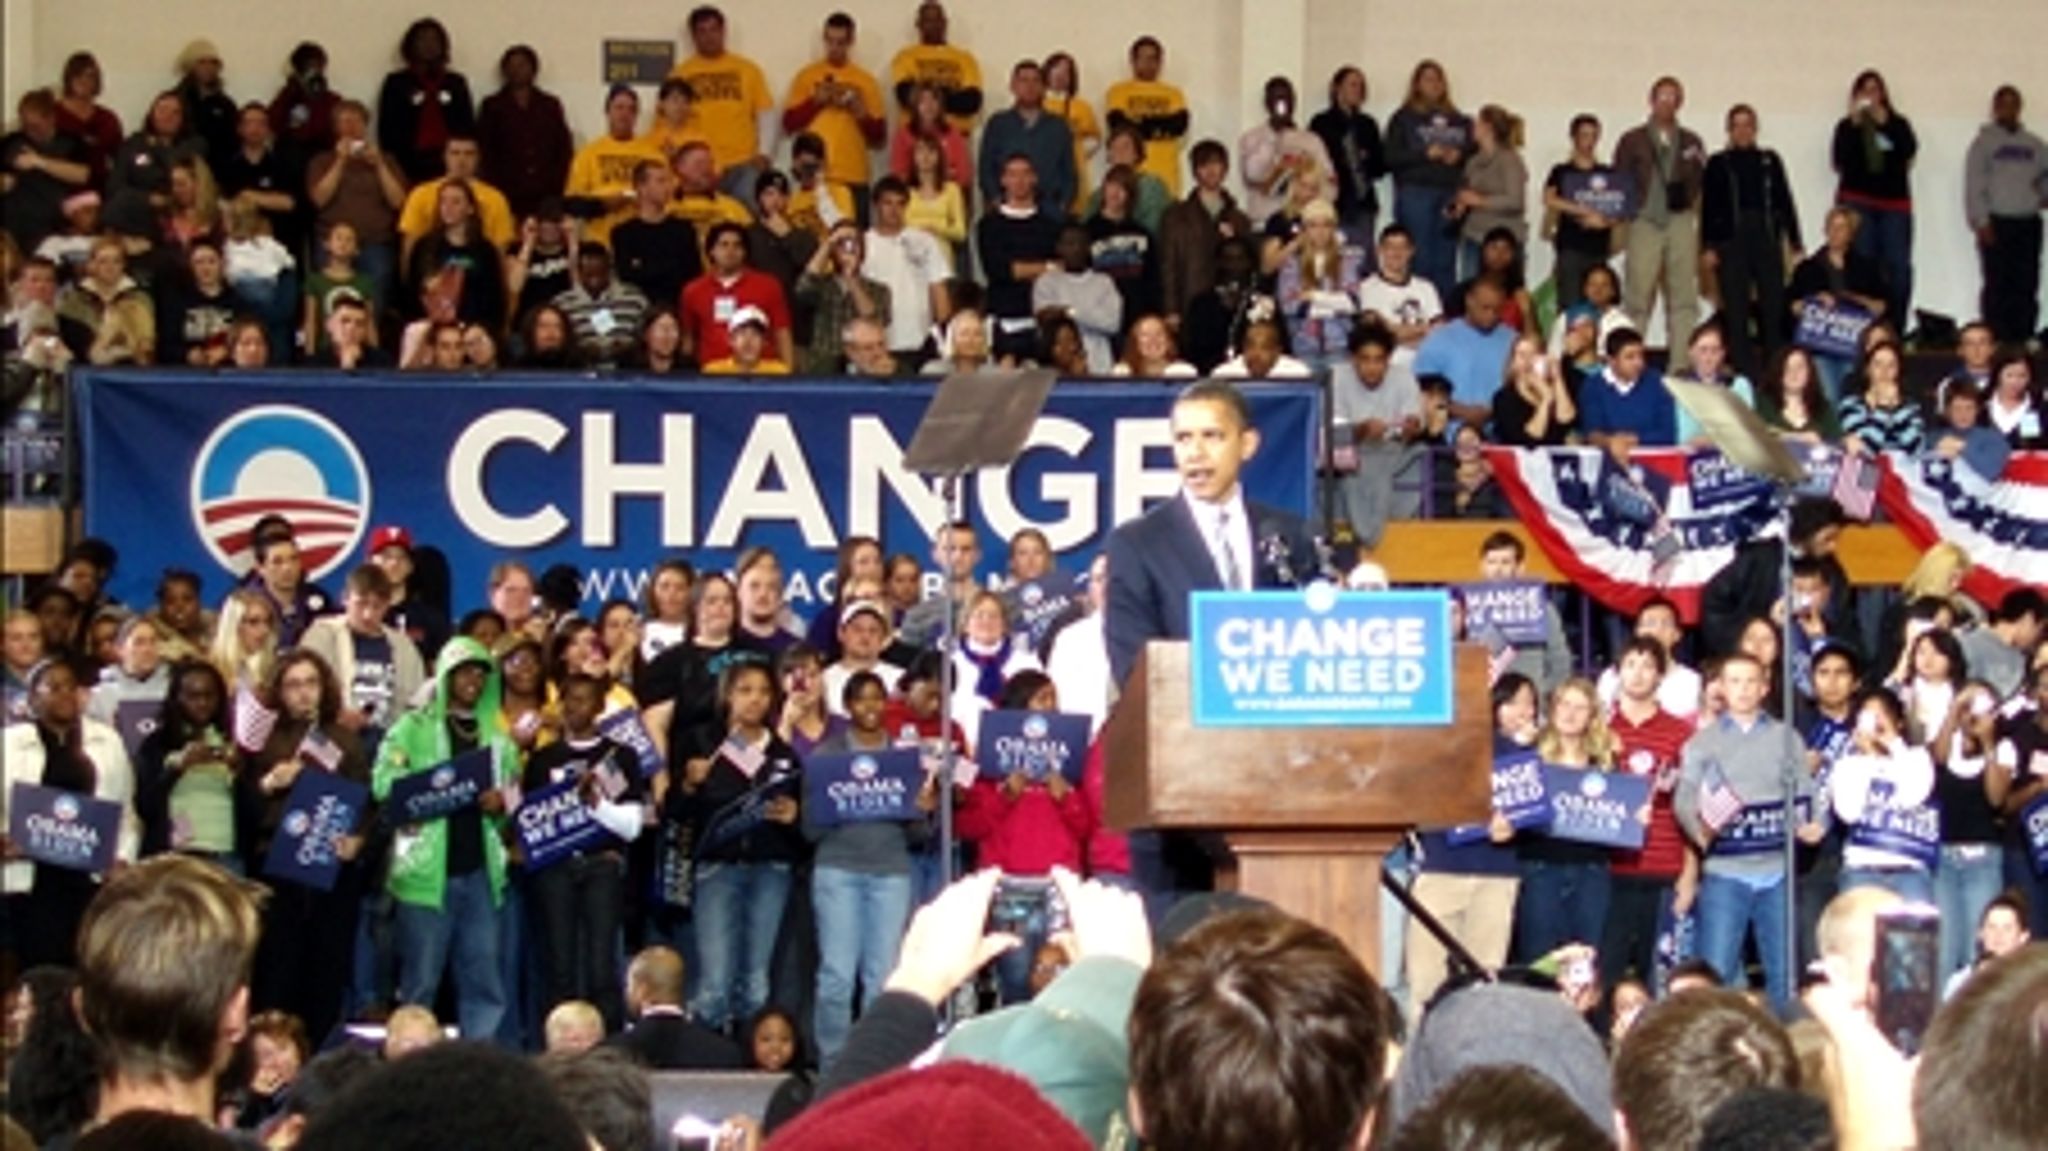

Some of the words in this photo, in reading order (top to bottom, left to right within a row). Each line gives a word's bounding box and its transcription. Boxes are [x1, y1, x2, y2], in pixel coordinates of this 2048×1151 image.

[1216, 617, 1426, 659] CHANGE
[1218, 659, 1293, 694] WE
[1305, 659, 1426, 694] NEED
[26, 813, 102, 848] OBAMA
